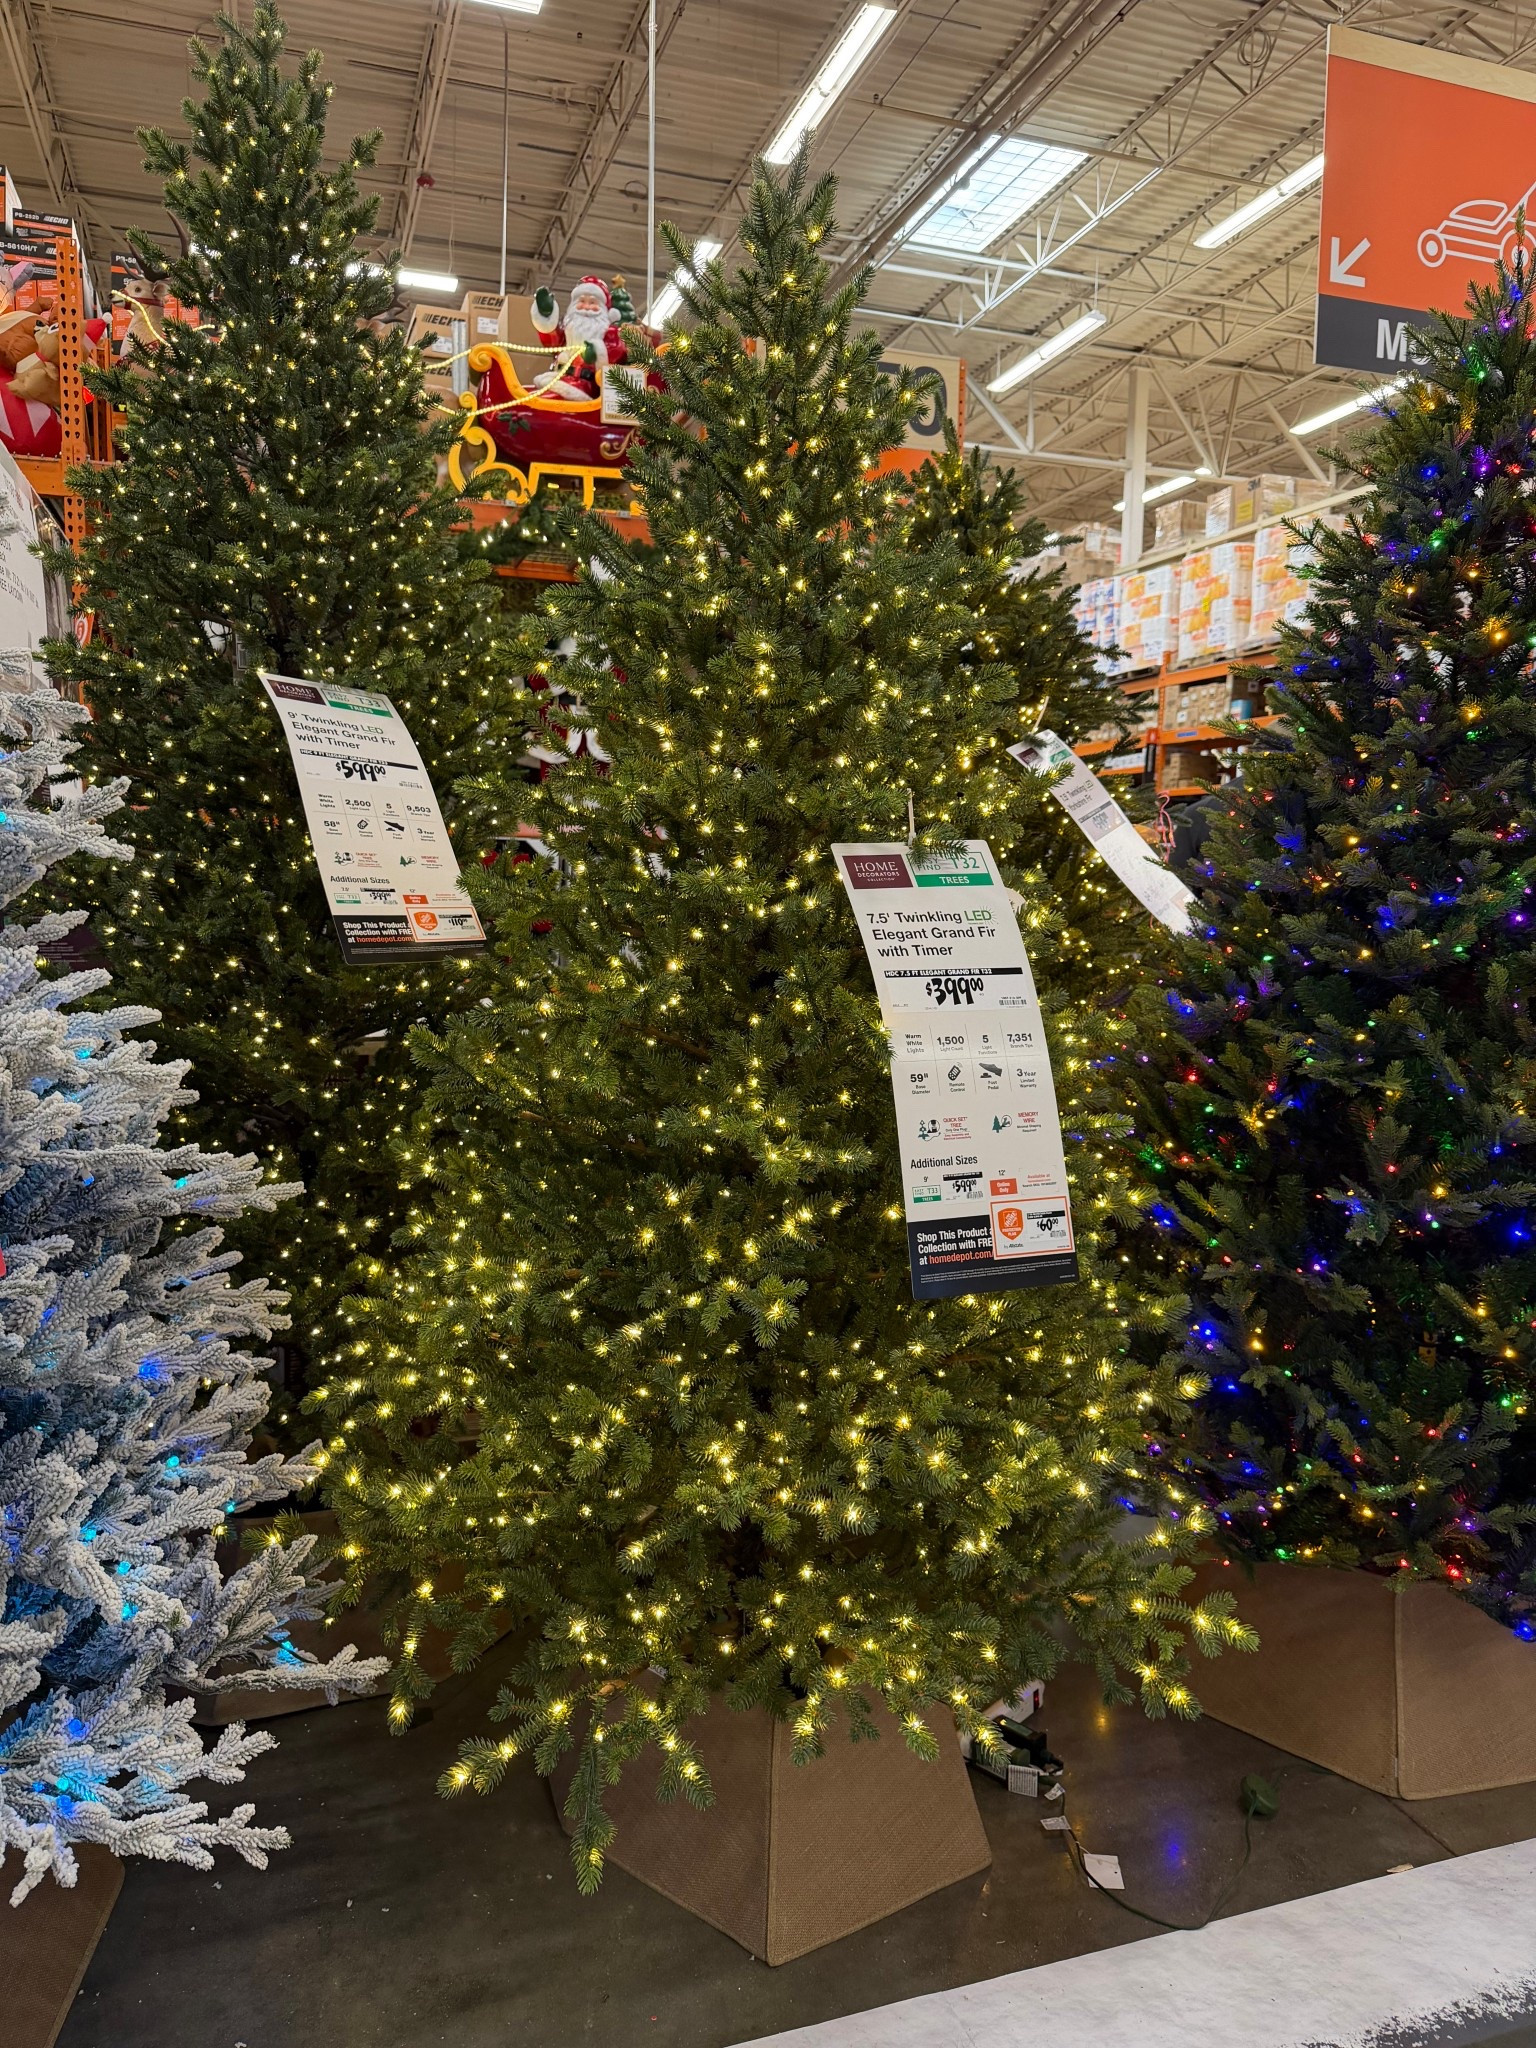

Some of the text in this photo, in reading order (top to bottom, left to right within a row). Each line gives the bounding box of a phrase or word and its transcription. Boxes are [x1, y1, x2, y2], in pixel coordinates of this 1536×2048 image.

[48, 216, 69, 225] ECHO
[480, 296, 504, 307] ECH
[276, 683, 312, 695] HOME
[355, 697, 381, 707] T33
[348, 705, 374, 714] TREES
[301, 713, 359, 731] Twinkling
[361, 724, 384, 735] LED
[292, 721, 396, 746] Elegant Grand Fir
[296, 734, 360, 750] with Timer
[345, 799, 371, 807] 2,500
[406, 805, 431, 813] 9,503
[853, 861, 899, 872] HOME
[950, 857, 980, 870] T32
[330, 875, 369, 884] Additional
[939, 876, 970, 885] TREES
[866, 910, 992, 925] 7.5' Twinkling LED
[342, 922, 362, 930] Shop
[872, 926, 996, 943] Elegant Grand Fir
[877, 944, 953, 957] with Timer
[936, 1035, 965, 1047] 1,500
[982, 1034, 989, 1043] 5
[1006, 1033, 1033, 1044] 7,351
[910, 1072, 929, 1083] 59"
[1016, 1068, 1023, 1077] 3
[910, 1155, 978, 1169] Additional Sizes
[917, 1226, 988, 1243] Shop This Product
[918, 1238, 993, 1254] Collection with FRE
[919, 1255, 928, 1265] at
